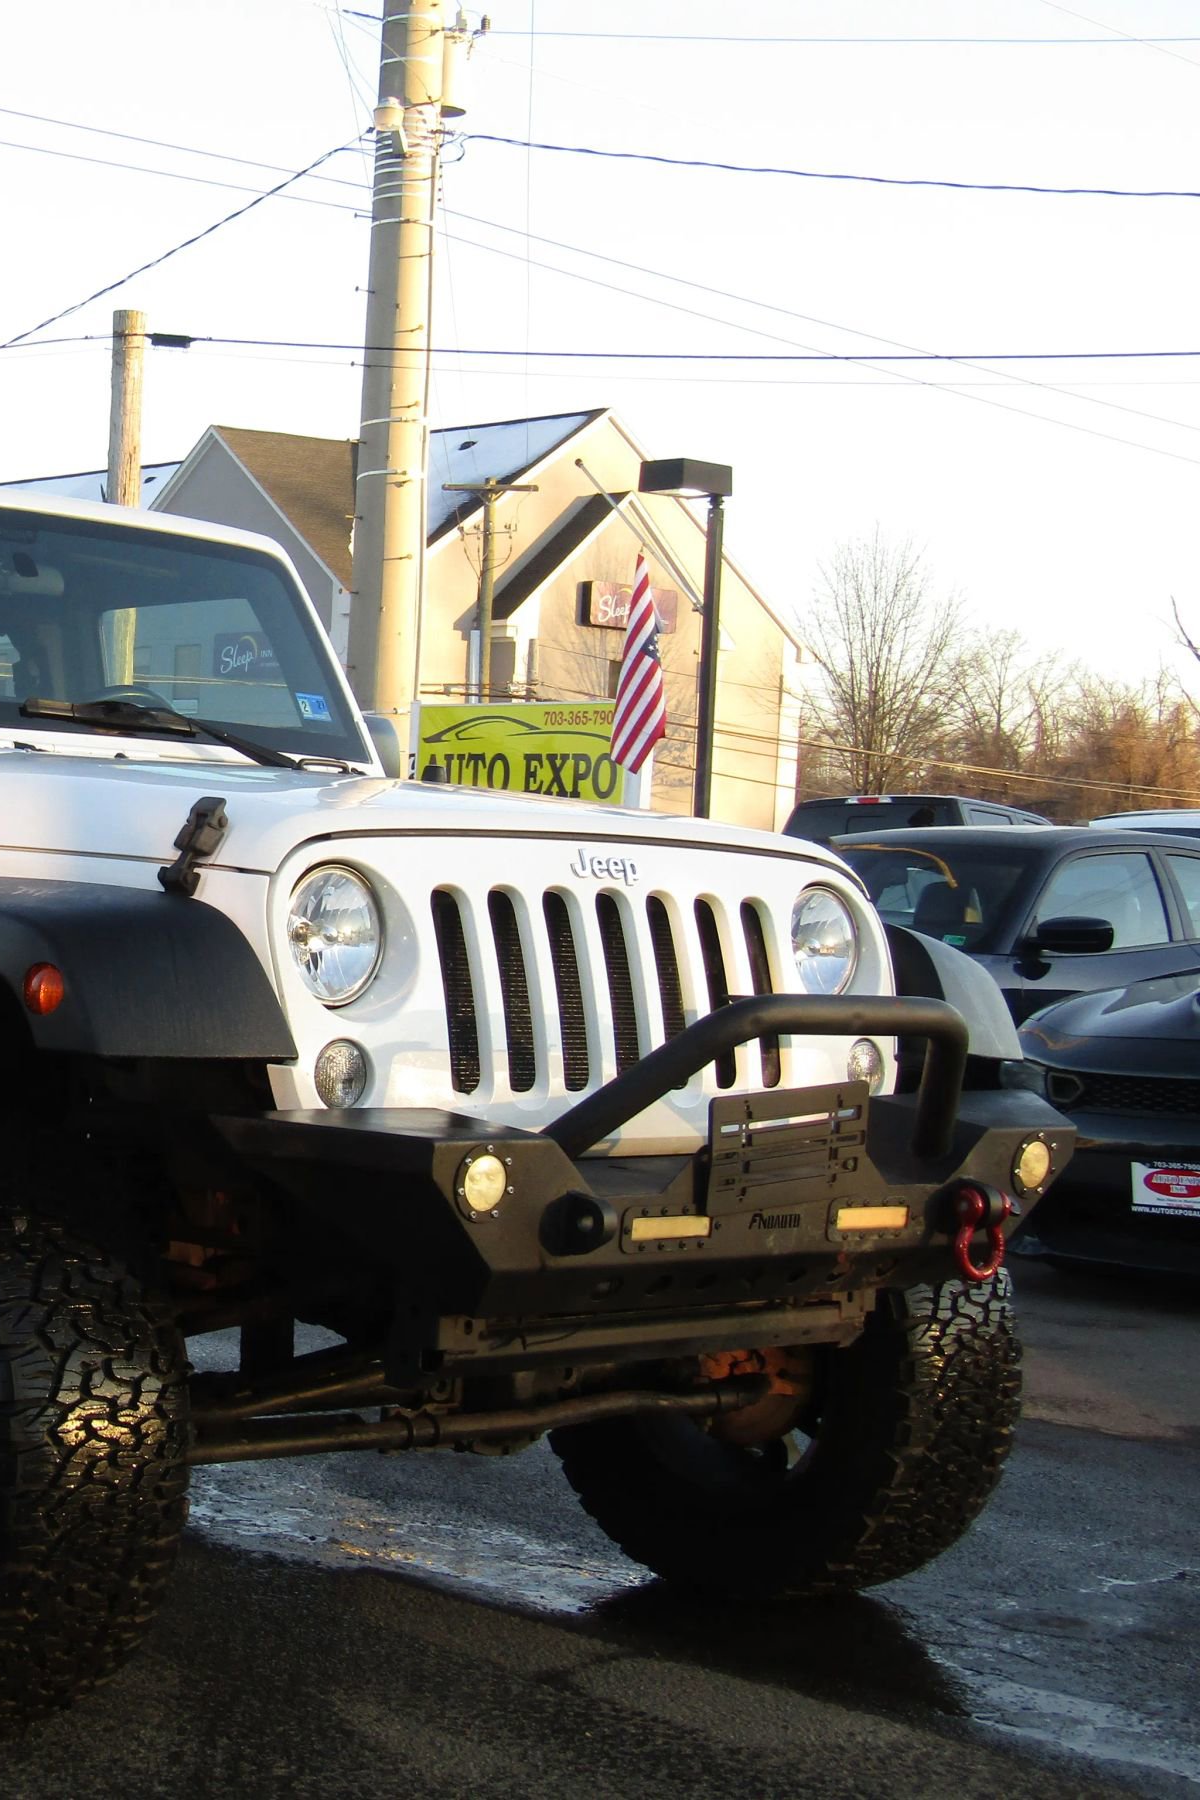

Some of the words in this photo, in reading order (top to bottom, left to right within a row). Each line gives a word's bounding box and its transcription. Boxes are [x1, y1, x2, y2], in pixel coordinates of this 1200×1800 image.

[220, 644, 254, 674] Sleep
[523, 752, 618, 800] EXPO
[569, 847, 640, 887] Jeep
